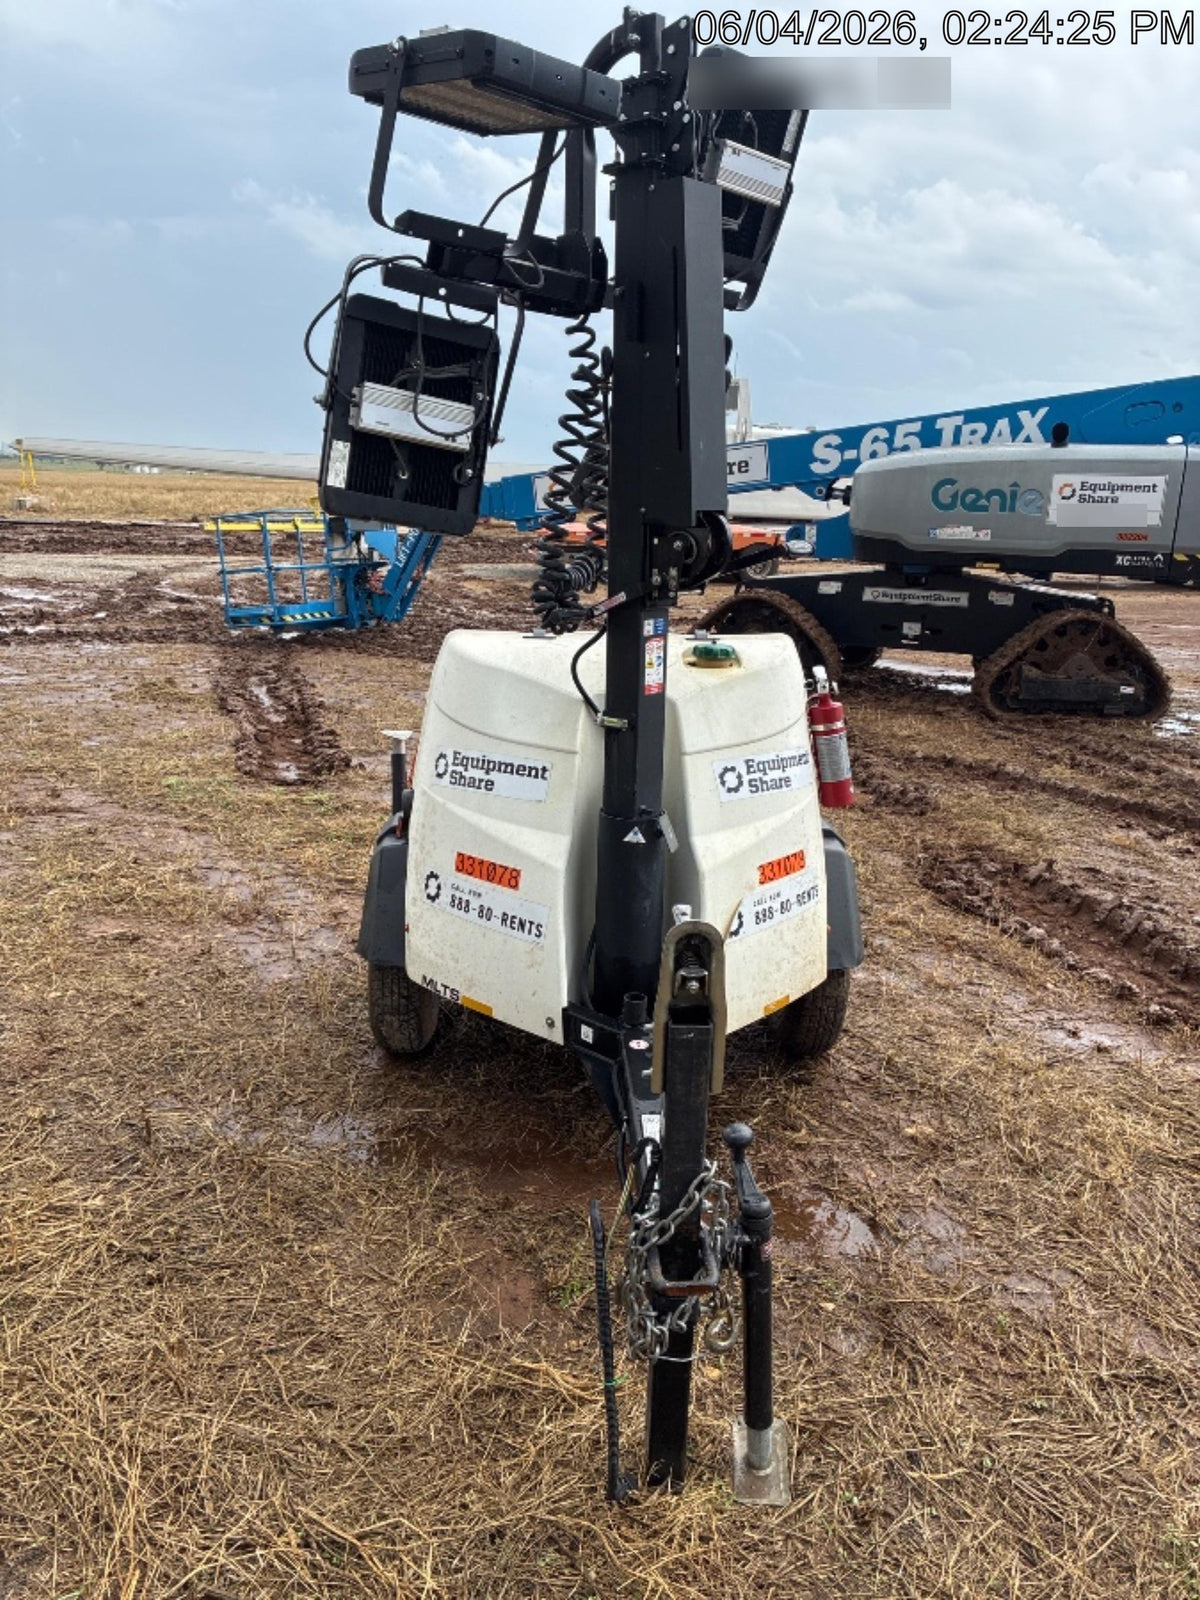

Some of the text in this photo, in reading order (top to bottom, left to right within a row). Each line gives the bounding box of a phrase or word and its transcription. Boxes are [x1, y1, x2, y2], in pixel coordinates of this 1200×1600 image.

[809, 406, 1050, 474] S-65 TRAX
[931, 476, 1044, 516] Genie
[1077, 494, 1119, 504] Share
[1080, 481, 1159, 494] Equipment
[451, 750, 549, 780] Equipment
[449, 769, 495, 791] Share
[748, 776, 792, 794] Share
[454, 852, 521, 891] 331078
[449, 893, 543, 938] 888-80-RENTS
[420, 974, 460, 1002] MLTS
